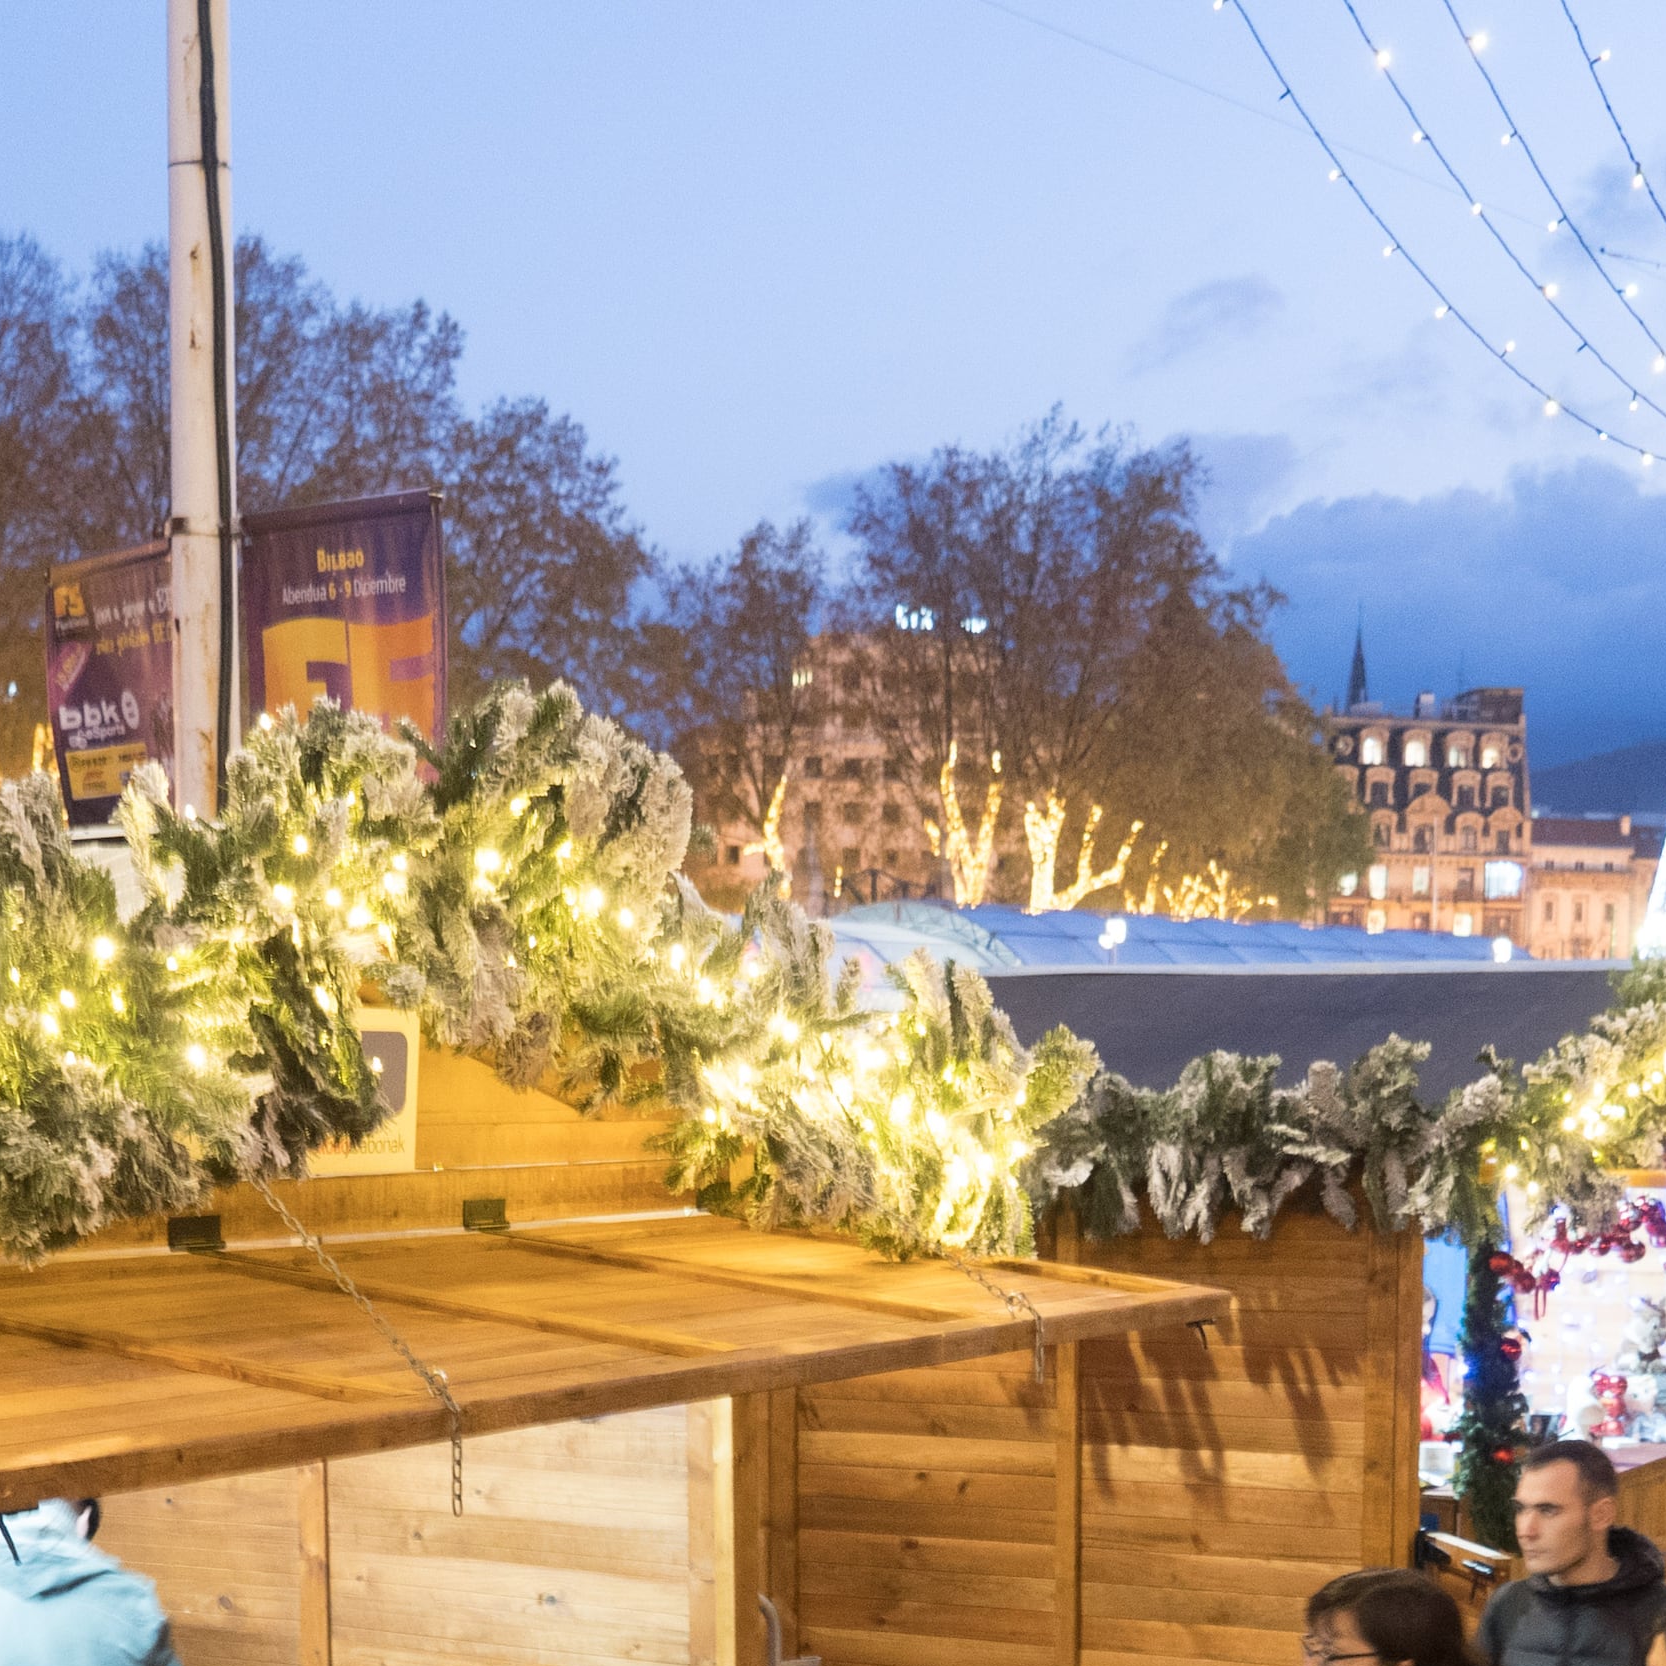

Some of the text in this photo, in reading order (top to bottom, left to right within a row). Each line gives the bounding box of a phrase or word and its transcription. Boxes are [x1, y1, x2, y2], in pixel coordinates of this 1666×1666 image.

[328, 581, 337, 600] 6
[344, 579, 352, 599] 9
[353, 570, 407, 598] Diciembre
[58, 697, 121, 731] bbk
